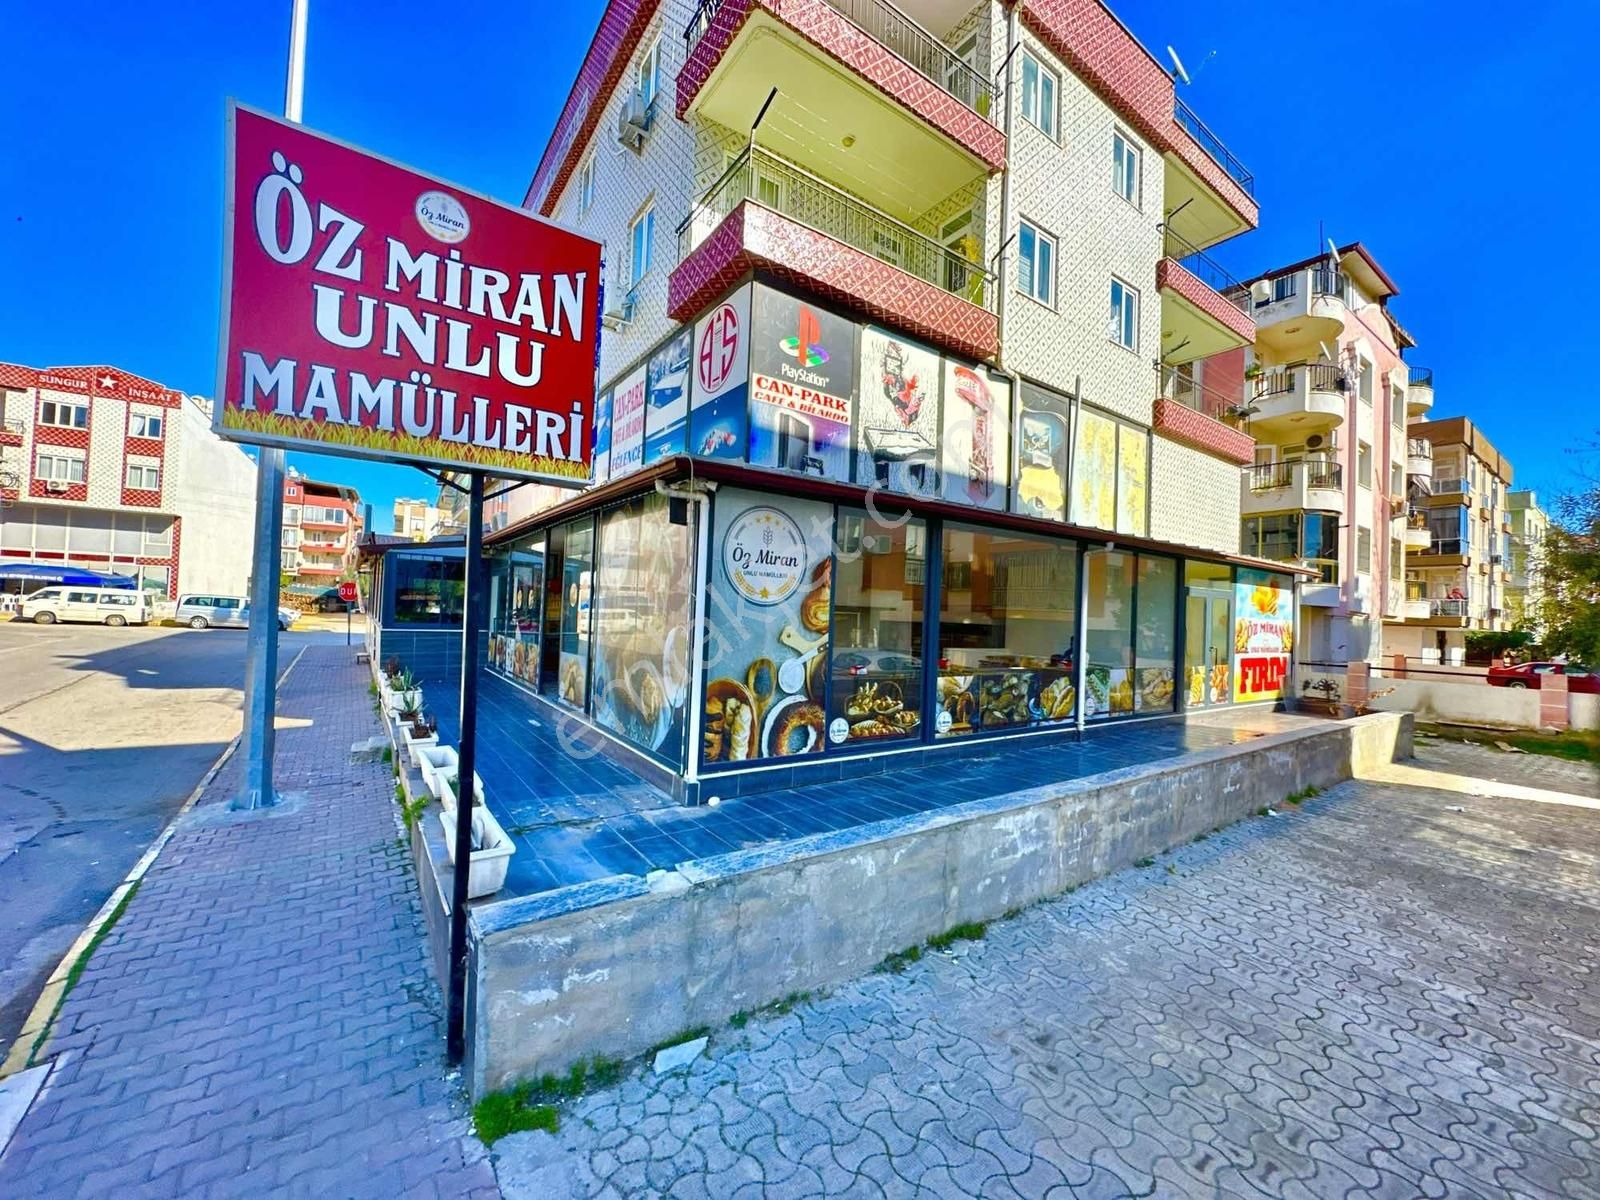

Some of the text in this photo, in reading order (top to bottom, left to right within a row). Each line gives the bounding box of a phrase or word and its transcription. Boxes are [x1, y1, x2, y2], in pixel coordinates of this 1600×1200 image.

[435, 212, 464, 229] Miran
[254, 150, 587, 342] ÖZ MİRAN
[313, 283, 546, 387] UNLU
[39, 374, 88, 389] SUNGUR
[756, 376, 848, 413] CAN-PARK
[240, 350, 584, 463] MAMÜLLERİ
[732, 542, 799, 570] Öz Miran
